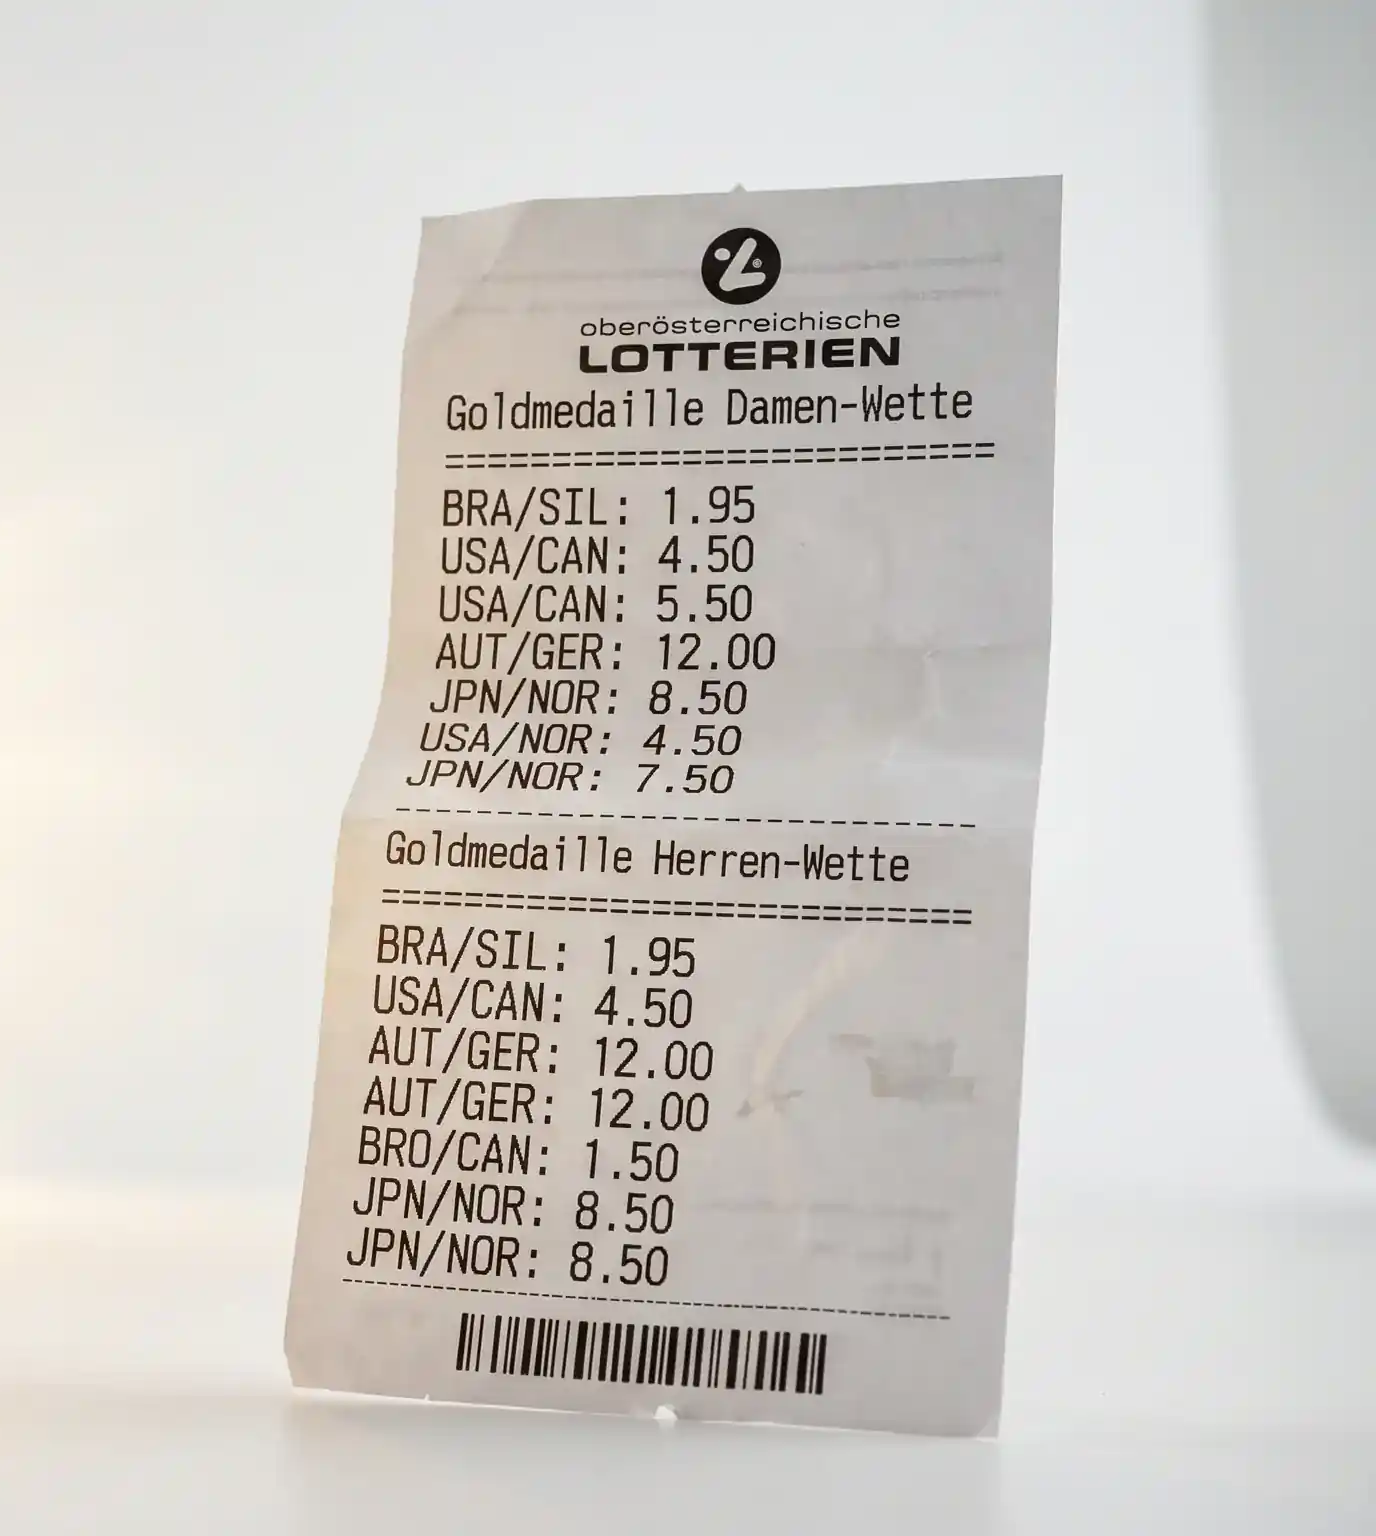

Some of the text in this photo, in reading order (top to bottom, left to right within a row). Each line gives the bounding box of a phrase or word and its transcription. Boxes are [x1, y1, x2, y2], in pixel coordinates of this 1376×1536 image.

[581, 309, 900, 336] oberösterreichische
[580, 336, 900, 373] LOTTERIEN
[447, 382, 972, 431] Goldmedaille Damen-Wette
[443, 485, 754, 532] BRA/SIL: 1.95
[442, 535, 754, 580] USA/CAN: 4.50
[440, 584, 752, 627] USA/CAN: 5.50
[436, 631, 775, 675] AUT/GER: 12.00
[430, 678, 747, 718] JPN/NOR: 8.50
[420, 722, 742, 756] USA/NOR: 4.50
[406, 759, 734, 793] JPN/NOR: 7.50
[387, 830, 909, 882] Goldmedaille Herren-Wette
[377, 924, 695, 977] BRA/SIL: 1.95
[374, 974, 692, 1028] USA/CAN: 4.50
[369, 1025, 713, 1081] AUT/GER: 12.00
[363, 1075, 709, 1132] AUT/GER: 12.00
[358, 1125, 679, 1182] BRO/CAN: 1.50
[353, 1177, 674, 1234] JPN/NOR: 8.50
[347, 1227, 668, 1286] JPN/NOR: 8.50
